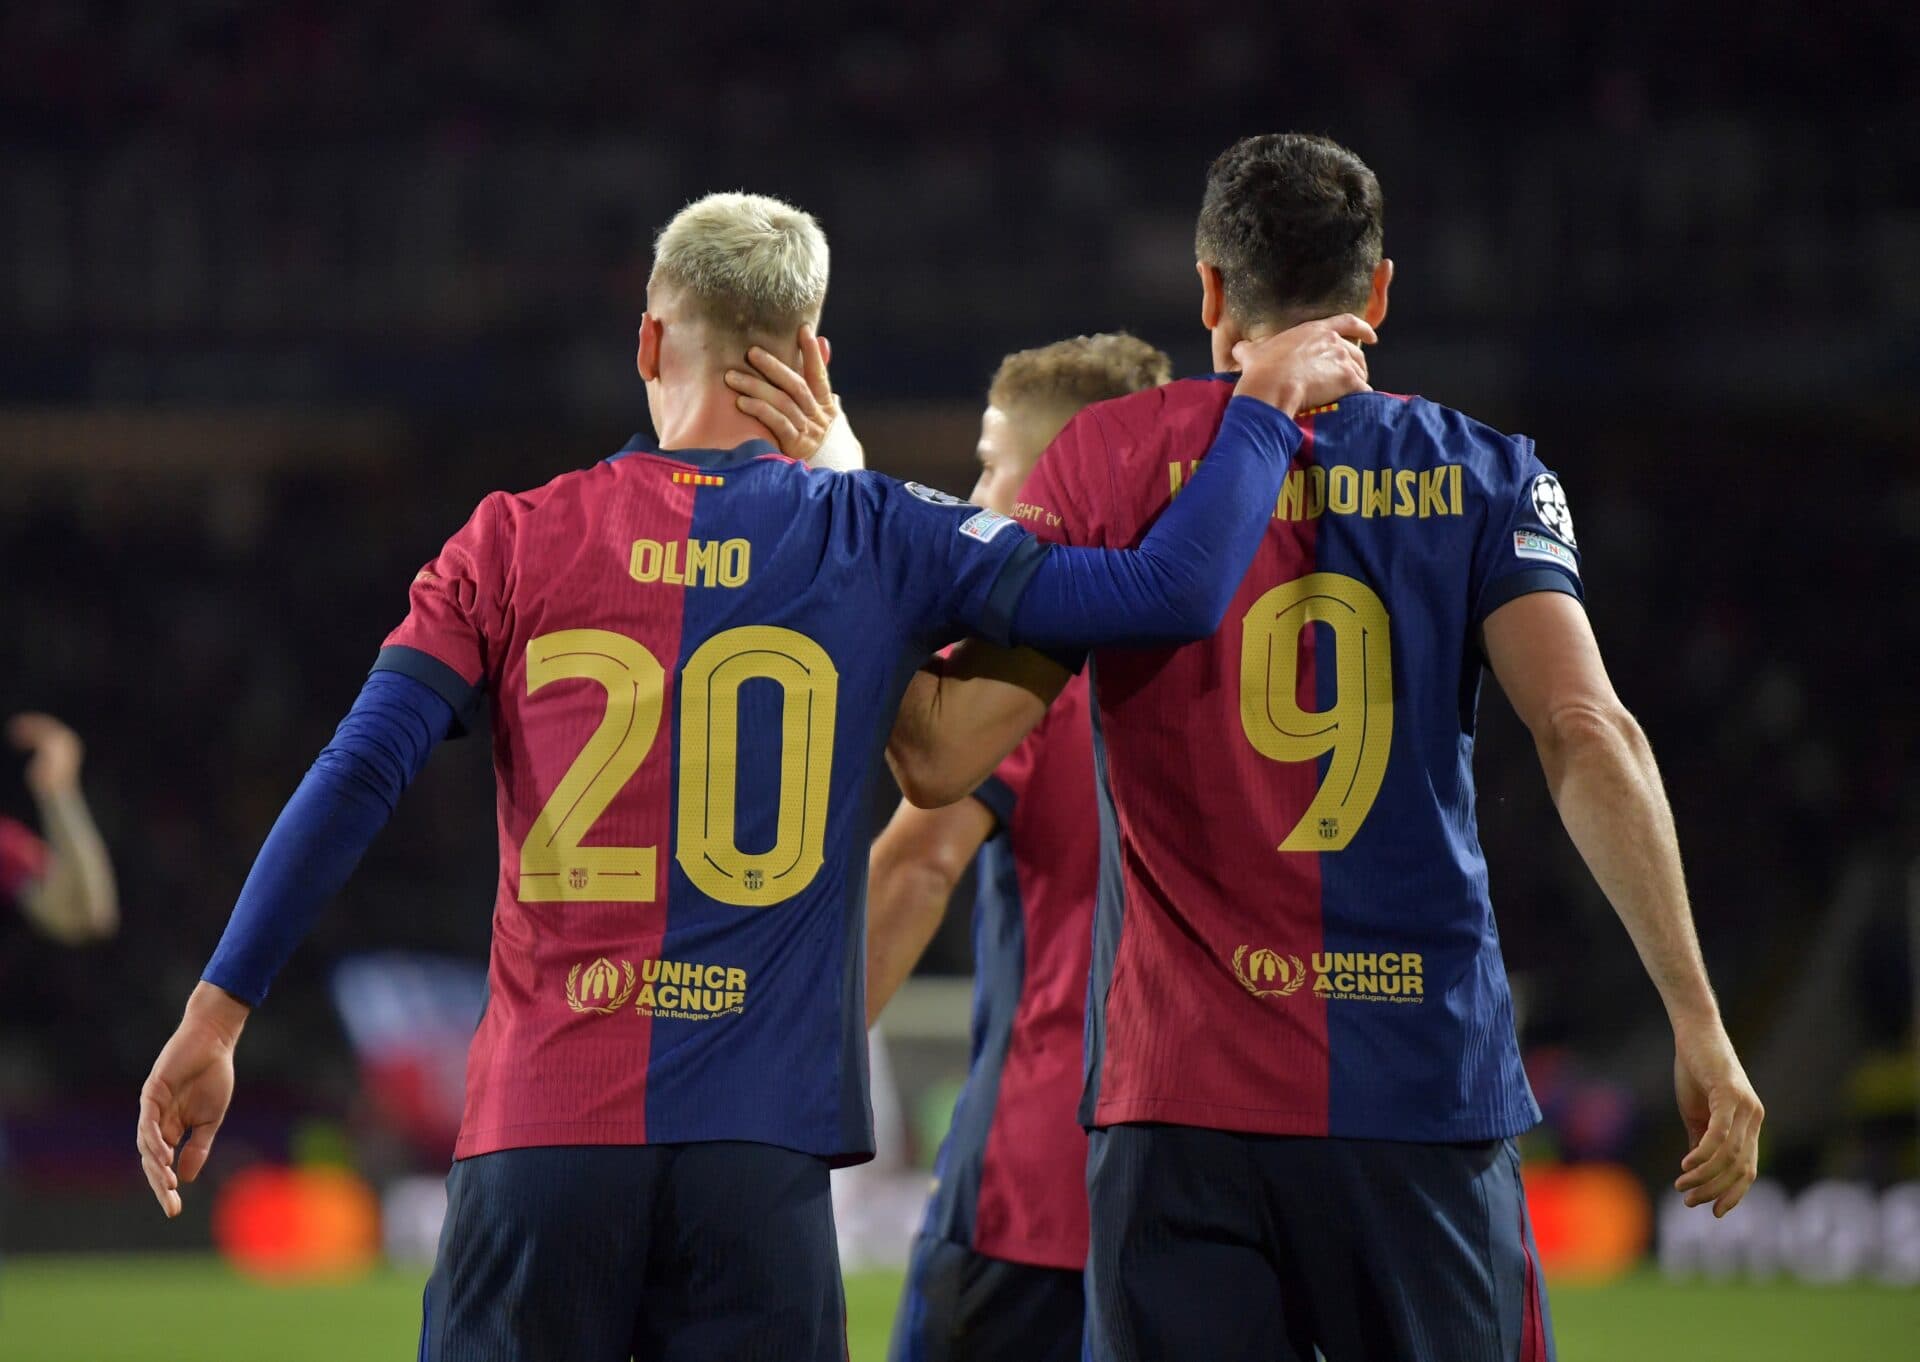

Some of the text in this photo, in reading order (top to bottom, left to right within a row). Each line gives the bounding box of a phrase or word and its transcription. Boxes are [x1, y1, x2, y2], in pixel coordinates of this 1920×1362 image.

[1168, 459, 1463, 521] NDOWSKI
[629, 538, 751, 588] OLMO
[1240, 572, 1393, 851] 9
[517, 625, 839, 907] 20
[642, 960, 747, 990] UNHCR
[1312, 952, 1423, 974] UNHCR
[635, 984, 745, 1011] ACNUR
[1312, 973, 1424, 994] ACNUR
[1349, 993, 1388, 1002] Refugee
[1389, 995, 1424, 1004] Agency
[635, 1007, 653, 1017] The
[654, 1009, 669, 1018] UN
[671, 1010, 709, 1021] Refugee
